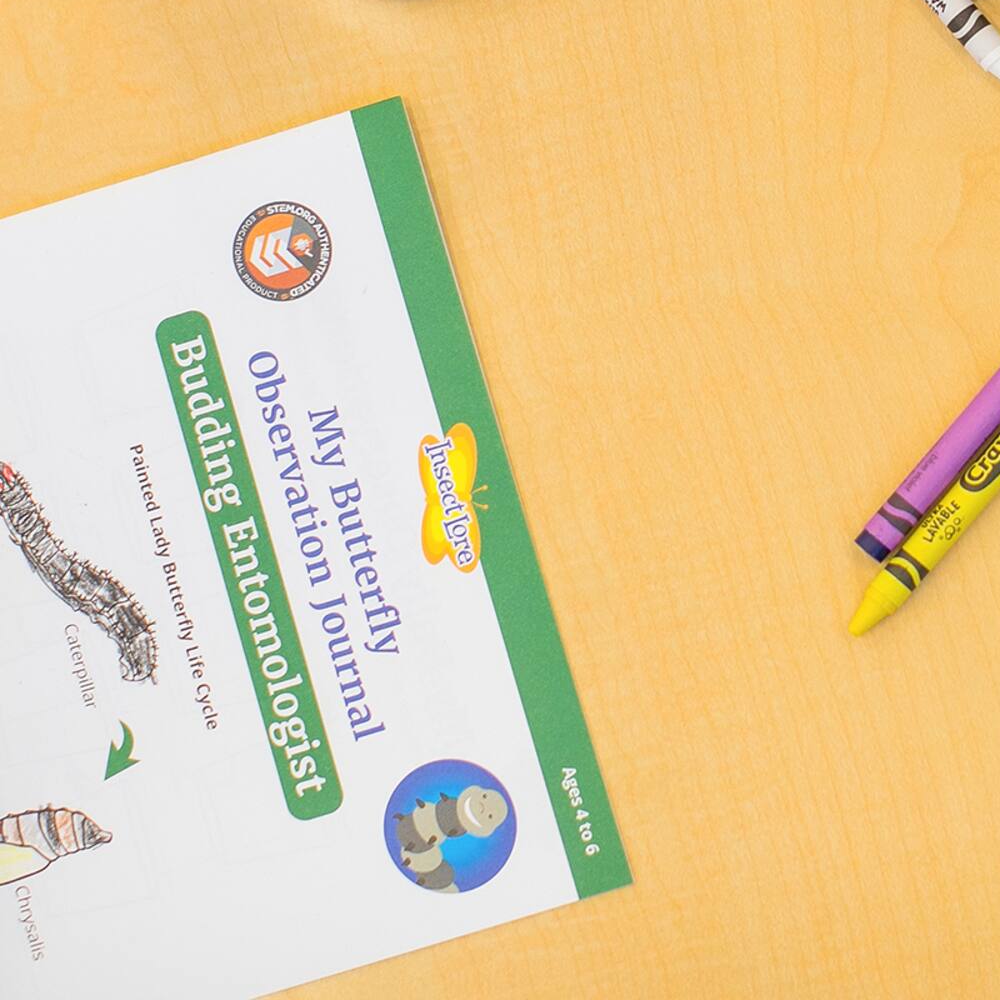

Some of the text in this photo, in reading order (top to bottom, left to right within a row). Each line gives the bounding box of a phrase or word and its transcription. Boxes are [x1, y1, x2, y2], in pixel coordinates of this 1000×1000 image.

[242, 274, 279, 299] PRODUCT
[248, 351, 386, 742] Observation Journal
[308, 405, 402, 655] My Butterfly
[425, 439, 473, 565] Insect Lore
[923, 500, 961, 543] LAVABLE
[130, 444, 218, 730] Painted Lady Butterfly Life Cycle
[171, 335, 328, 798] Budding Entomologist
[64, 622, 97, 710] Caterpillar
[562, 767, 600, 856] Ages 4 to 6
[15, 884, 45, 962] Chrysalis
